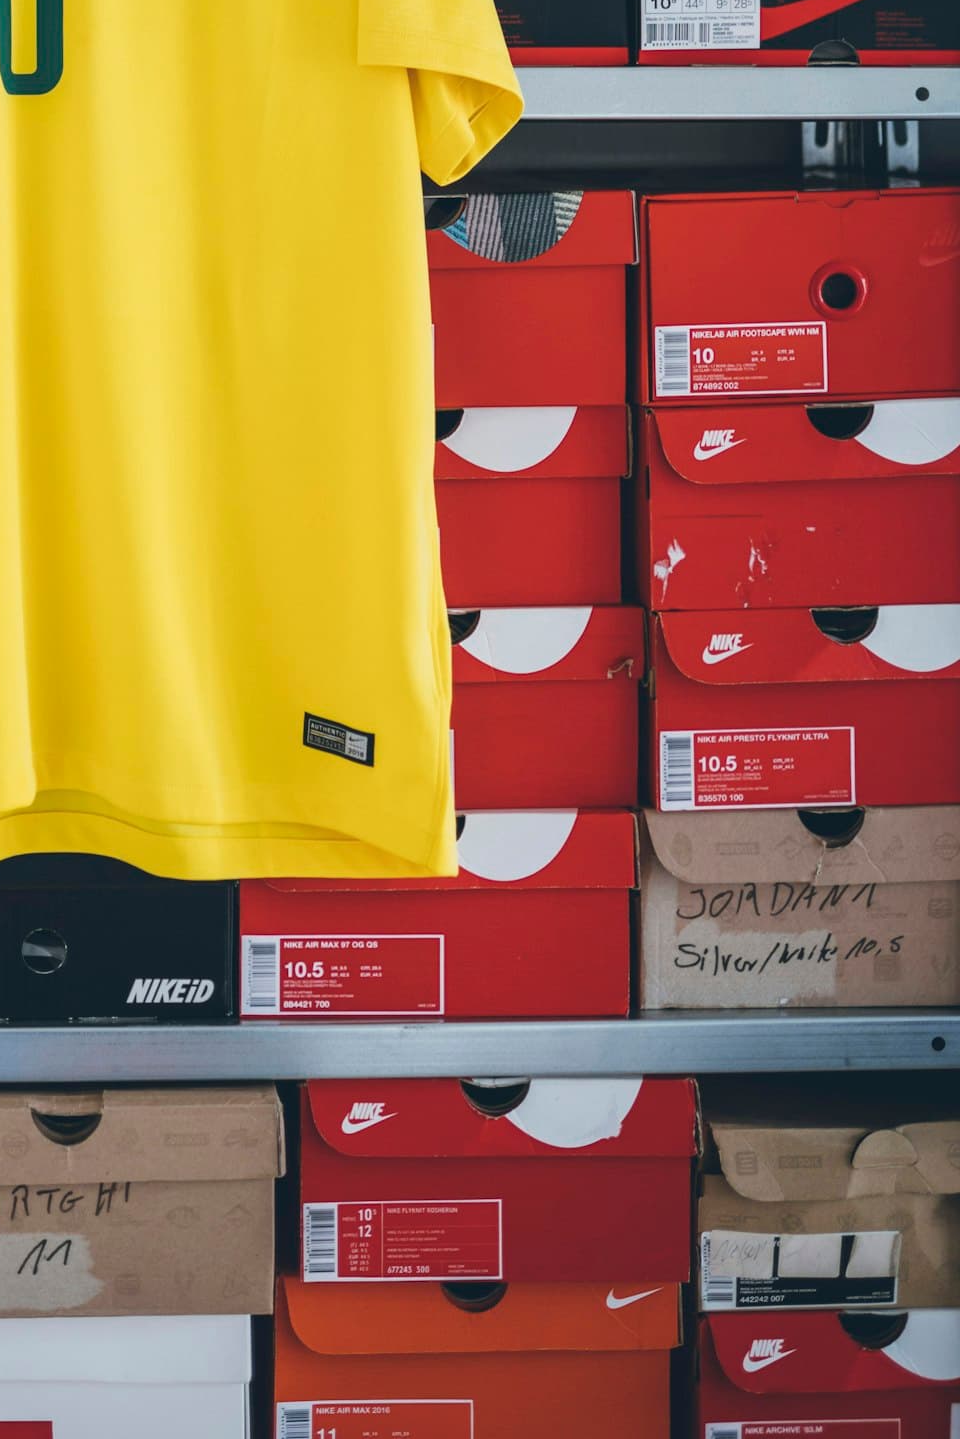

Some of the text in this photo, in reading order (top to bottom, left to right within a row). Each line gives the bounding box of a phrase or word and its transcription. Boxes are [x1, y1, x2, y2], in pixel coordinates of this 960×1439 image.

[692, 327, 819, 340] NIKELAB AIR FOOTSCAPE WVN NM
[692, 348, 715, 364] 10
[693, 382, 739, 391] 874892 002
[700, 429, 736, 447] NIKE
[709, 634, 743, 651] NIKE
[311, 722, 346, 738] AUTHENTIC
[697, 732, 829, 744] NIKE AIR PRESTO FLYKNIT ULTRA
[698, 755, 737, 773] 10.5
[283, 940, 378, 950] NIKE AIR MAX 97 OG QS
[283, 961, 324, 979] 10.5
[126, 978, 215, 1004] NIKEiD
[350, 1102, 385, 1121] NIKE
[357, 1225, 372, 1238] 12
[739, 1295, 785, 1304] 442242 007
[750, 1339, 785, 1358] NIKE
[315, 1406, 391, 1415] NIKE AIR MAX 2016
[765, 1426, 801, 1434] ARCHIVE
